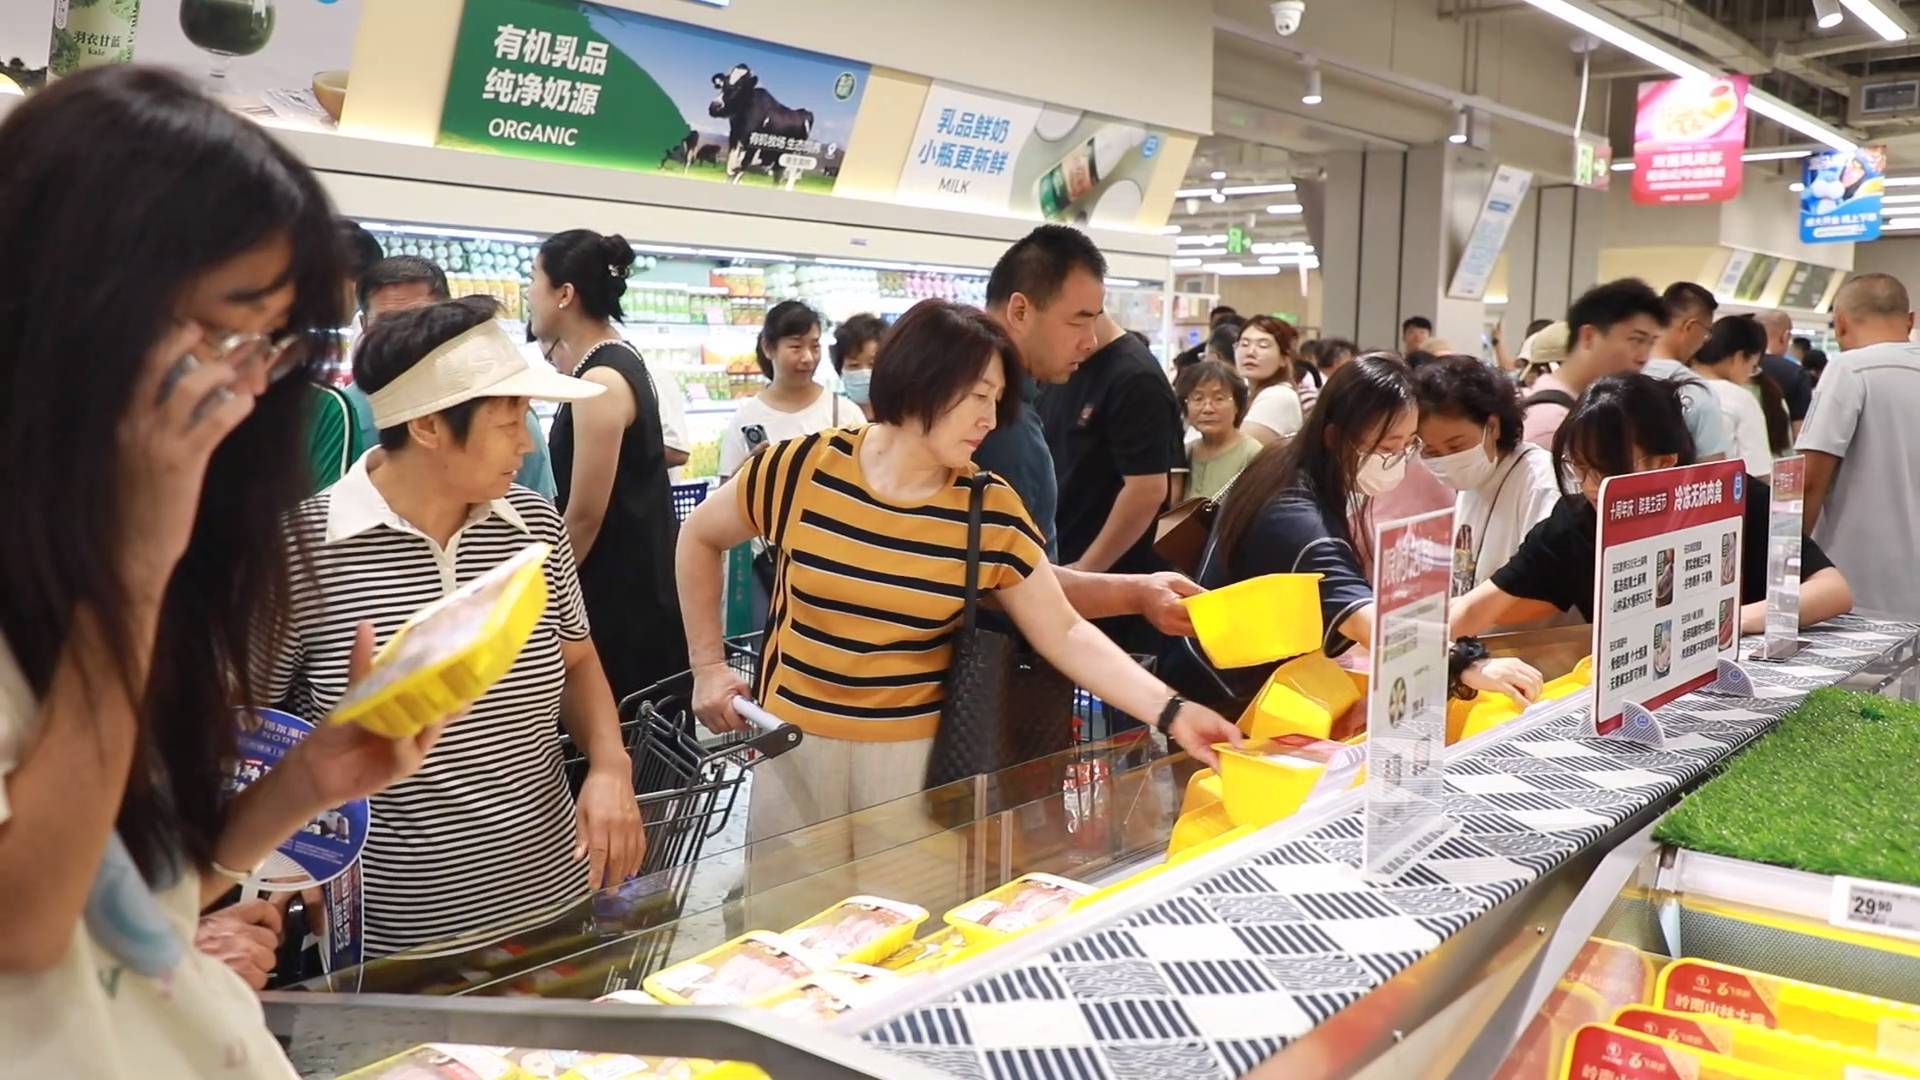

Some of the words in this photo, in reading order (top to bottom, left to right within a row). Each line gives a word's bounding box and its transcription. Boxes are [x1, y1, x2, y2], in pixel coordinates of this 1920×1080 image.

[73, 31, 121, 48] 羽衣甘蓝
[88, 47, 105, 56] kale
[494, 24, 609, 75] 有机乳品
[482, 67, 601, 115] 纯净奶源
[488, 118, 578, 146] ORGANIC
[937, 108, 1010, 143] 乳品鲜奶
[918, 139, 1010, 175] 小瓶更新鲜
[938, 177, 971, 194] MILK
[1674, 479, 1722, 511] 冷冻无抗肉禽
